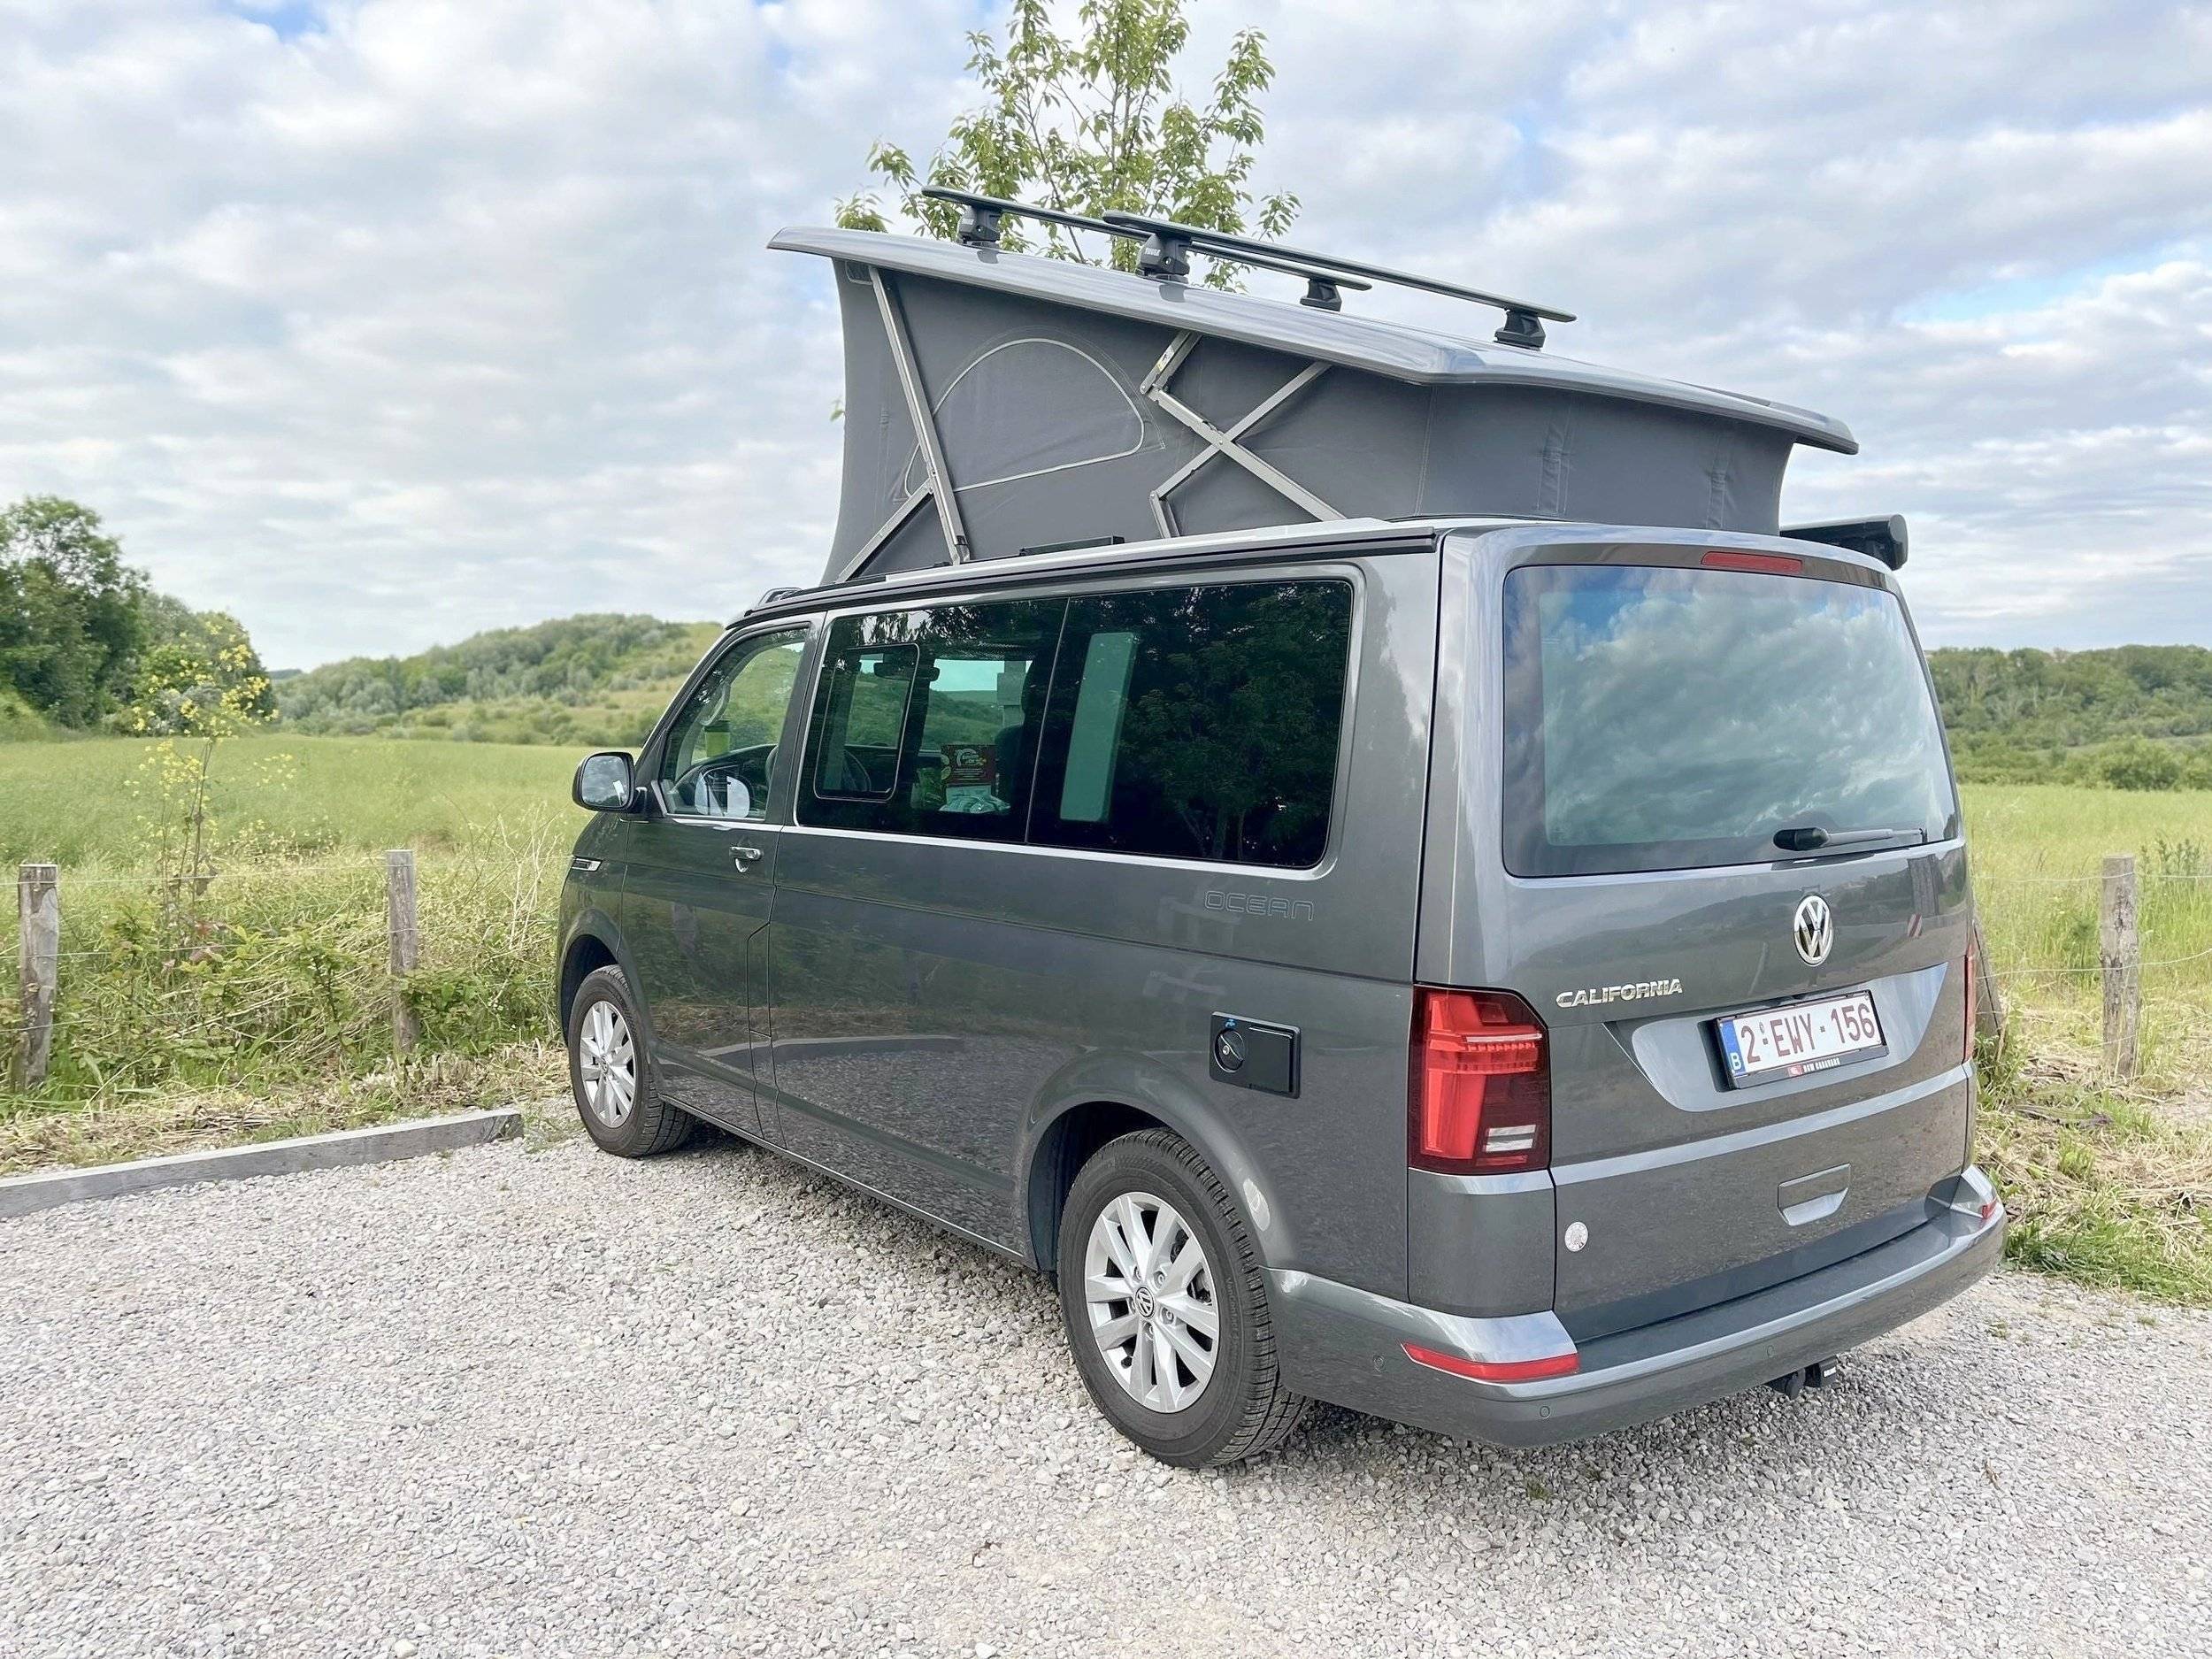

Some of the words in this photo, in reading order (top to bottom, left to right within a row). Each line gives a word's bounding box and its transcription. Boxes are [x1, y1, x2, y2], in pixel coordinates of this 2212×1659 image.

[1204, 891, 1314, 921] OCEAN
[1555, 978, 1683, 1009] CALIFORNIA
[1731, 1052, 1741, 1071] B
